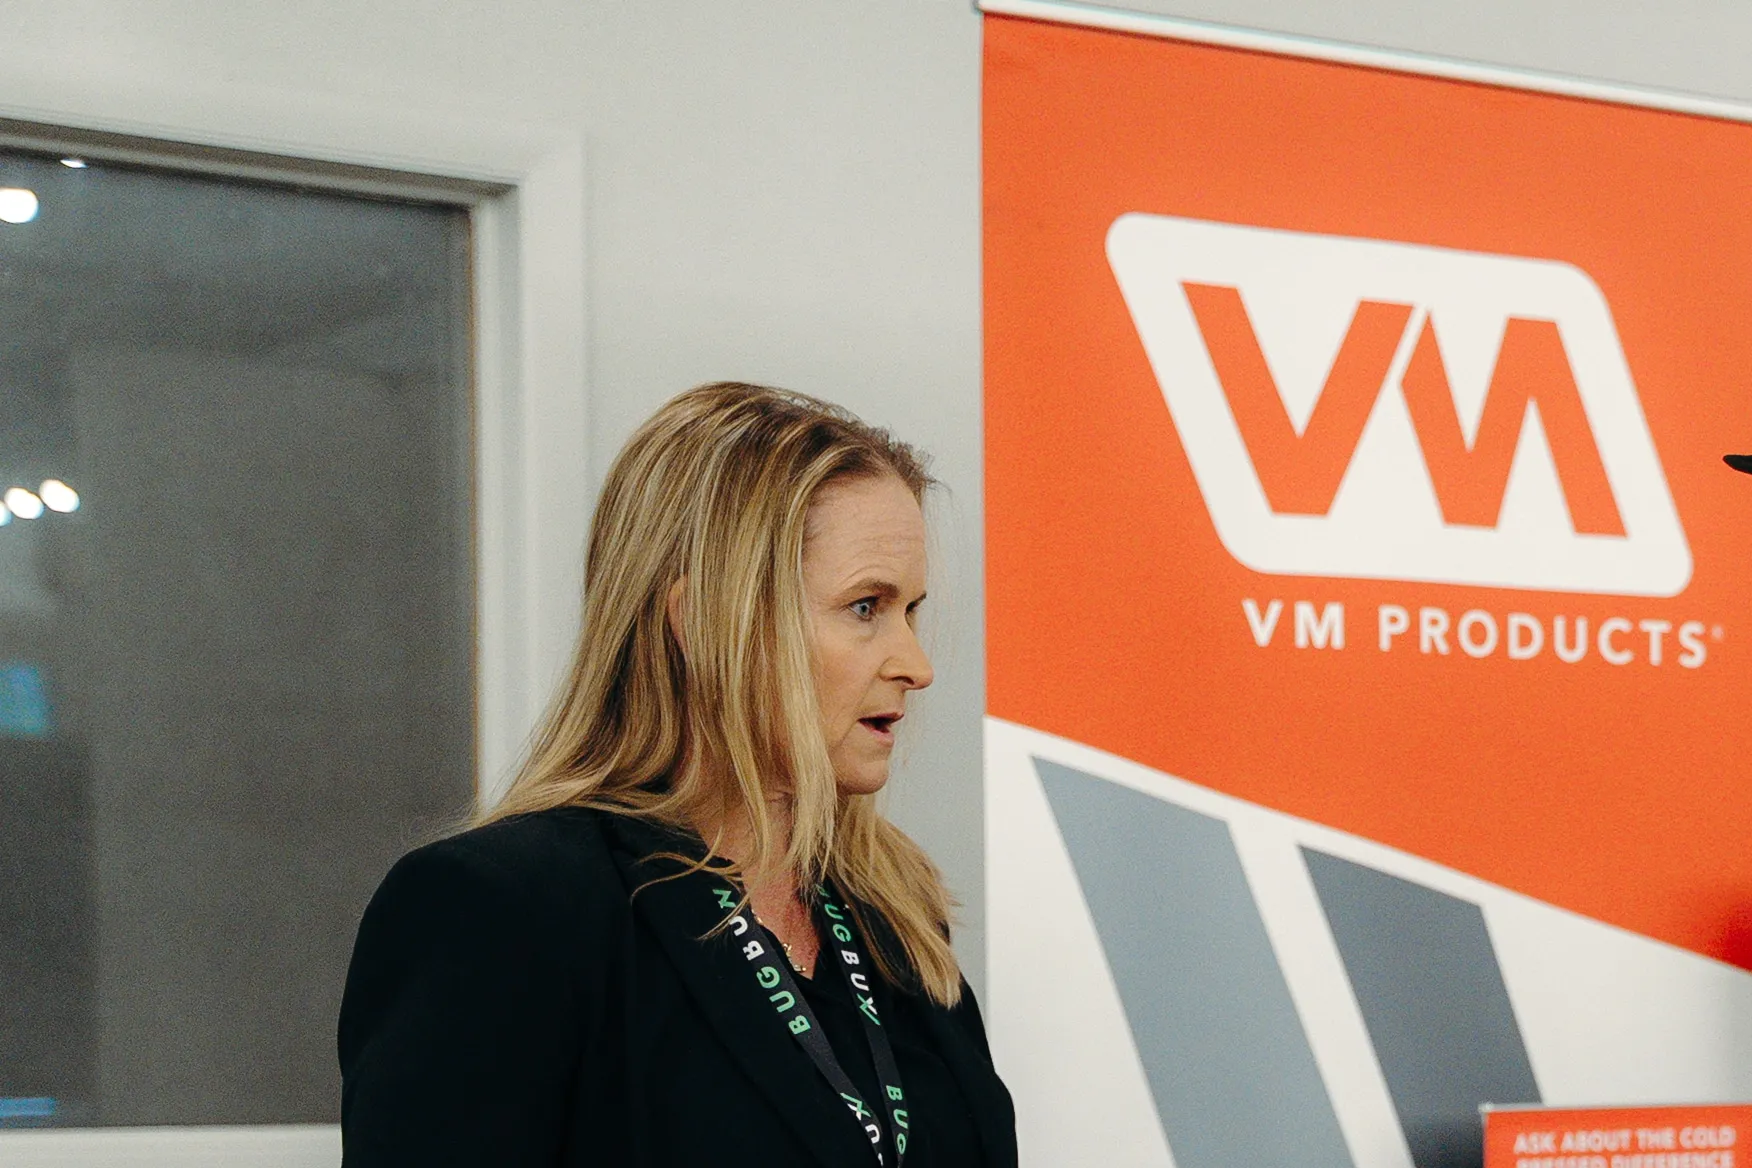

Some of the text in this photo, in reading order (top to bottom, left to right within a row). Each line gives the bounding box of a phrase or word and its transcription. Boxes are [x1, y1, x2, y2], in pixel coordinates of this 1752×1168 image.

[1242, 598, 1346, 650] VM
[1514, 1126, 1737, 1155] ASK ABOUT THE COLD
